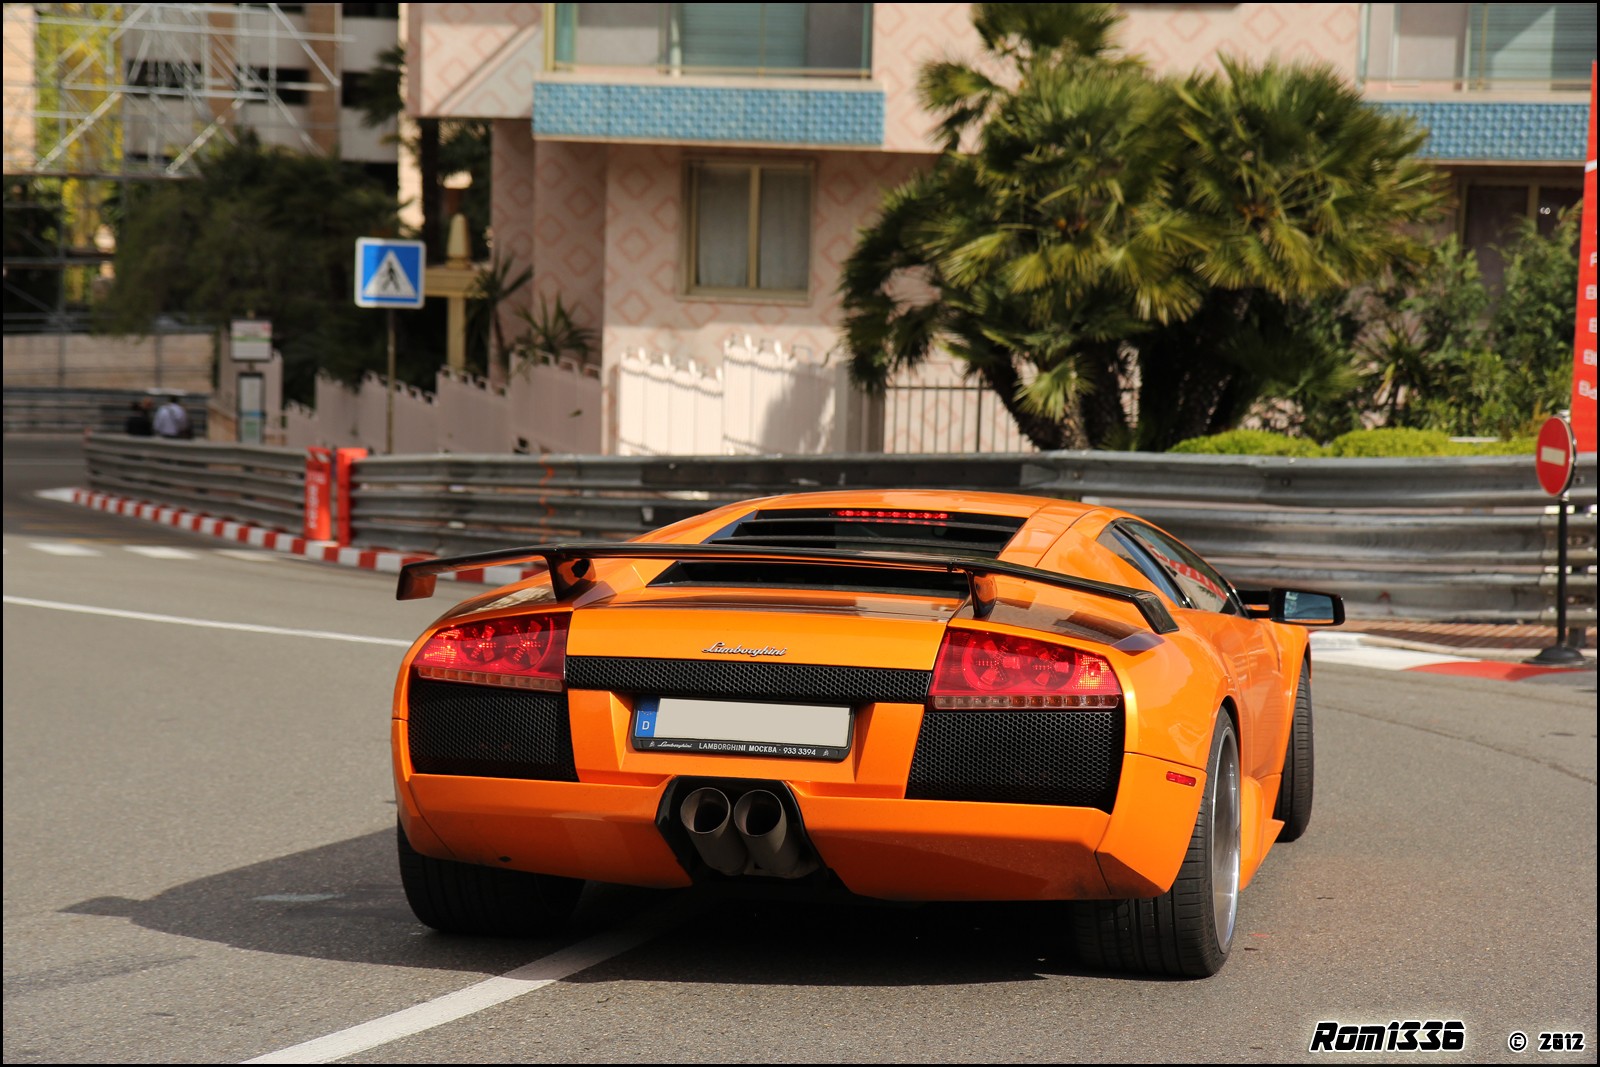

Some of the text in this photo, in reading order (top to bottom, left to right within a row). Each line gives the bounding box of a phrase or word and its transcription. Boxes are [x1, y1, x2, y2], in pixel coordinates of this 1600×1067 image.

[702, 642, 788, 657] Lamborghini
[642, 720, 650, 730] D
[698, 742, 746, 752] LAMBORGHINI
[783, 746, 797, 755] 933
[797, 748, 816, 756] 3394
